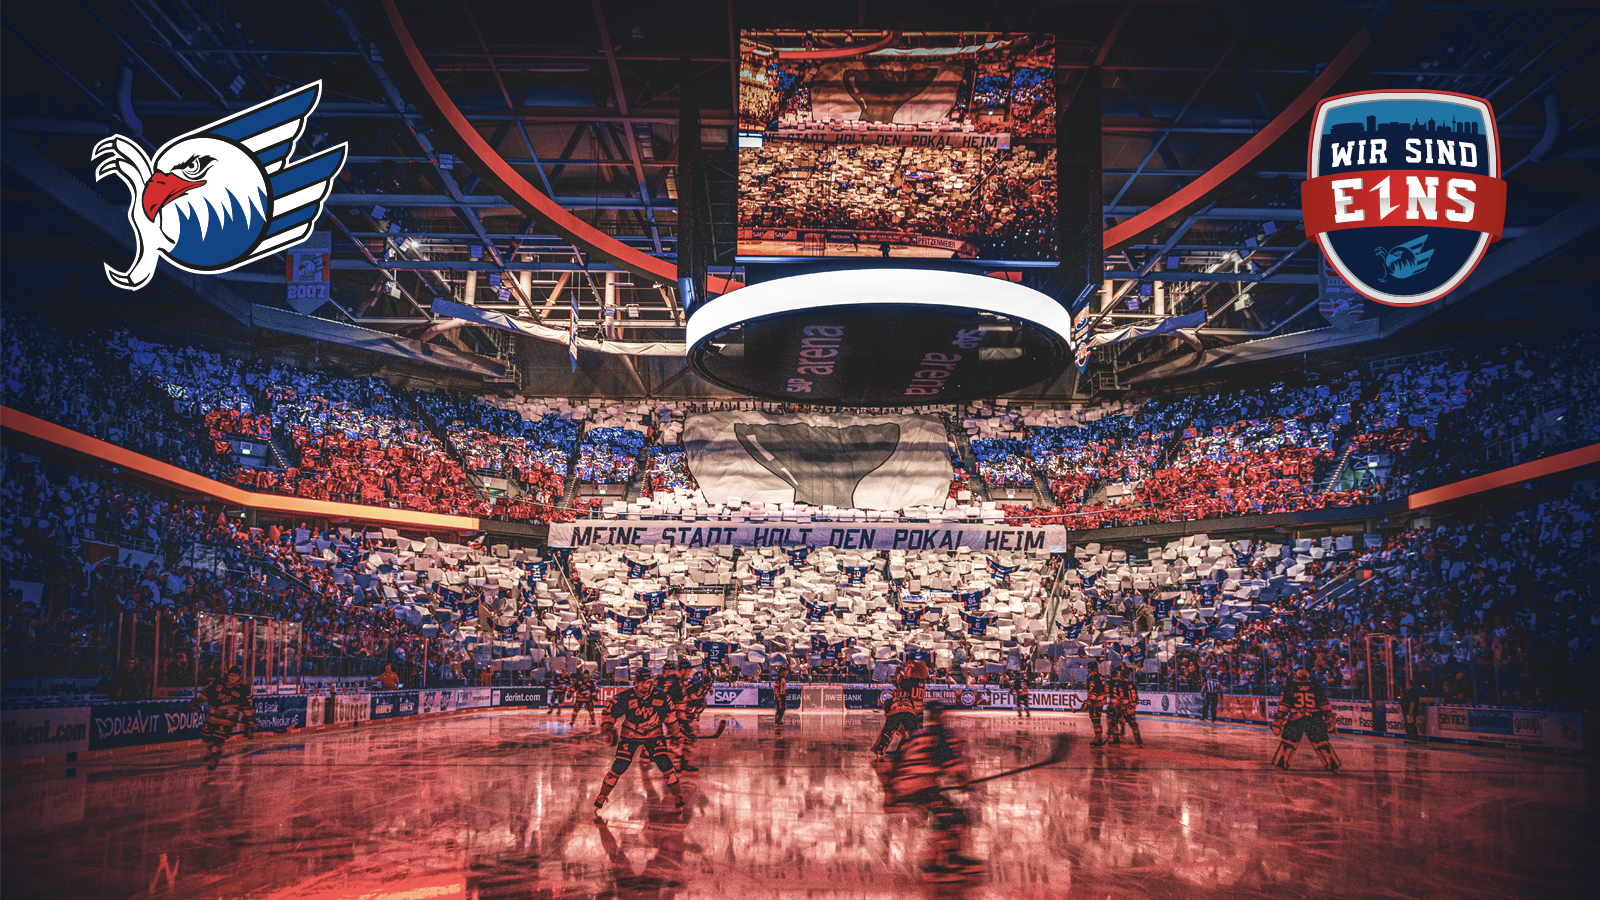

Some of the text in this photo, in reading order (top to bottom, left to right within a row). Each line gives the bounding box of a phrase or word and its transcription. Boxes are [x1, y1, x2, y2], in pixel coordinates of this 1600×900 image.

[876, 135, 902, 146] DEN
[911, 135, 952, 147] POKAL
[963, 136, 998, 148] HEIM
[917, 236, 956, 249] PFITZENMEIER
[287, 285, 326, 299] 2007
[797, 325, 845, 375] arena
[904, 352, 962, 395] arena
[570, 527, 1046, 551] MEINE STADT HOLT DEN POKAL HEIM
[504, 692, 541, 702] dorint.com
[715, 690, 737, 702] SAP
[992, 692, 1077, 706] PFITENMEIER
[1293, 692, 1316, 708] 35
[264, 700, 278, 713] Bank
[334, 696, 368, 723] tburger
[114, 709, 160, 736] DURAVIT
[1336, 716, 1353, 726] eiten
[1440, 712, 1540, 734] service innovation group
